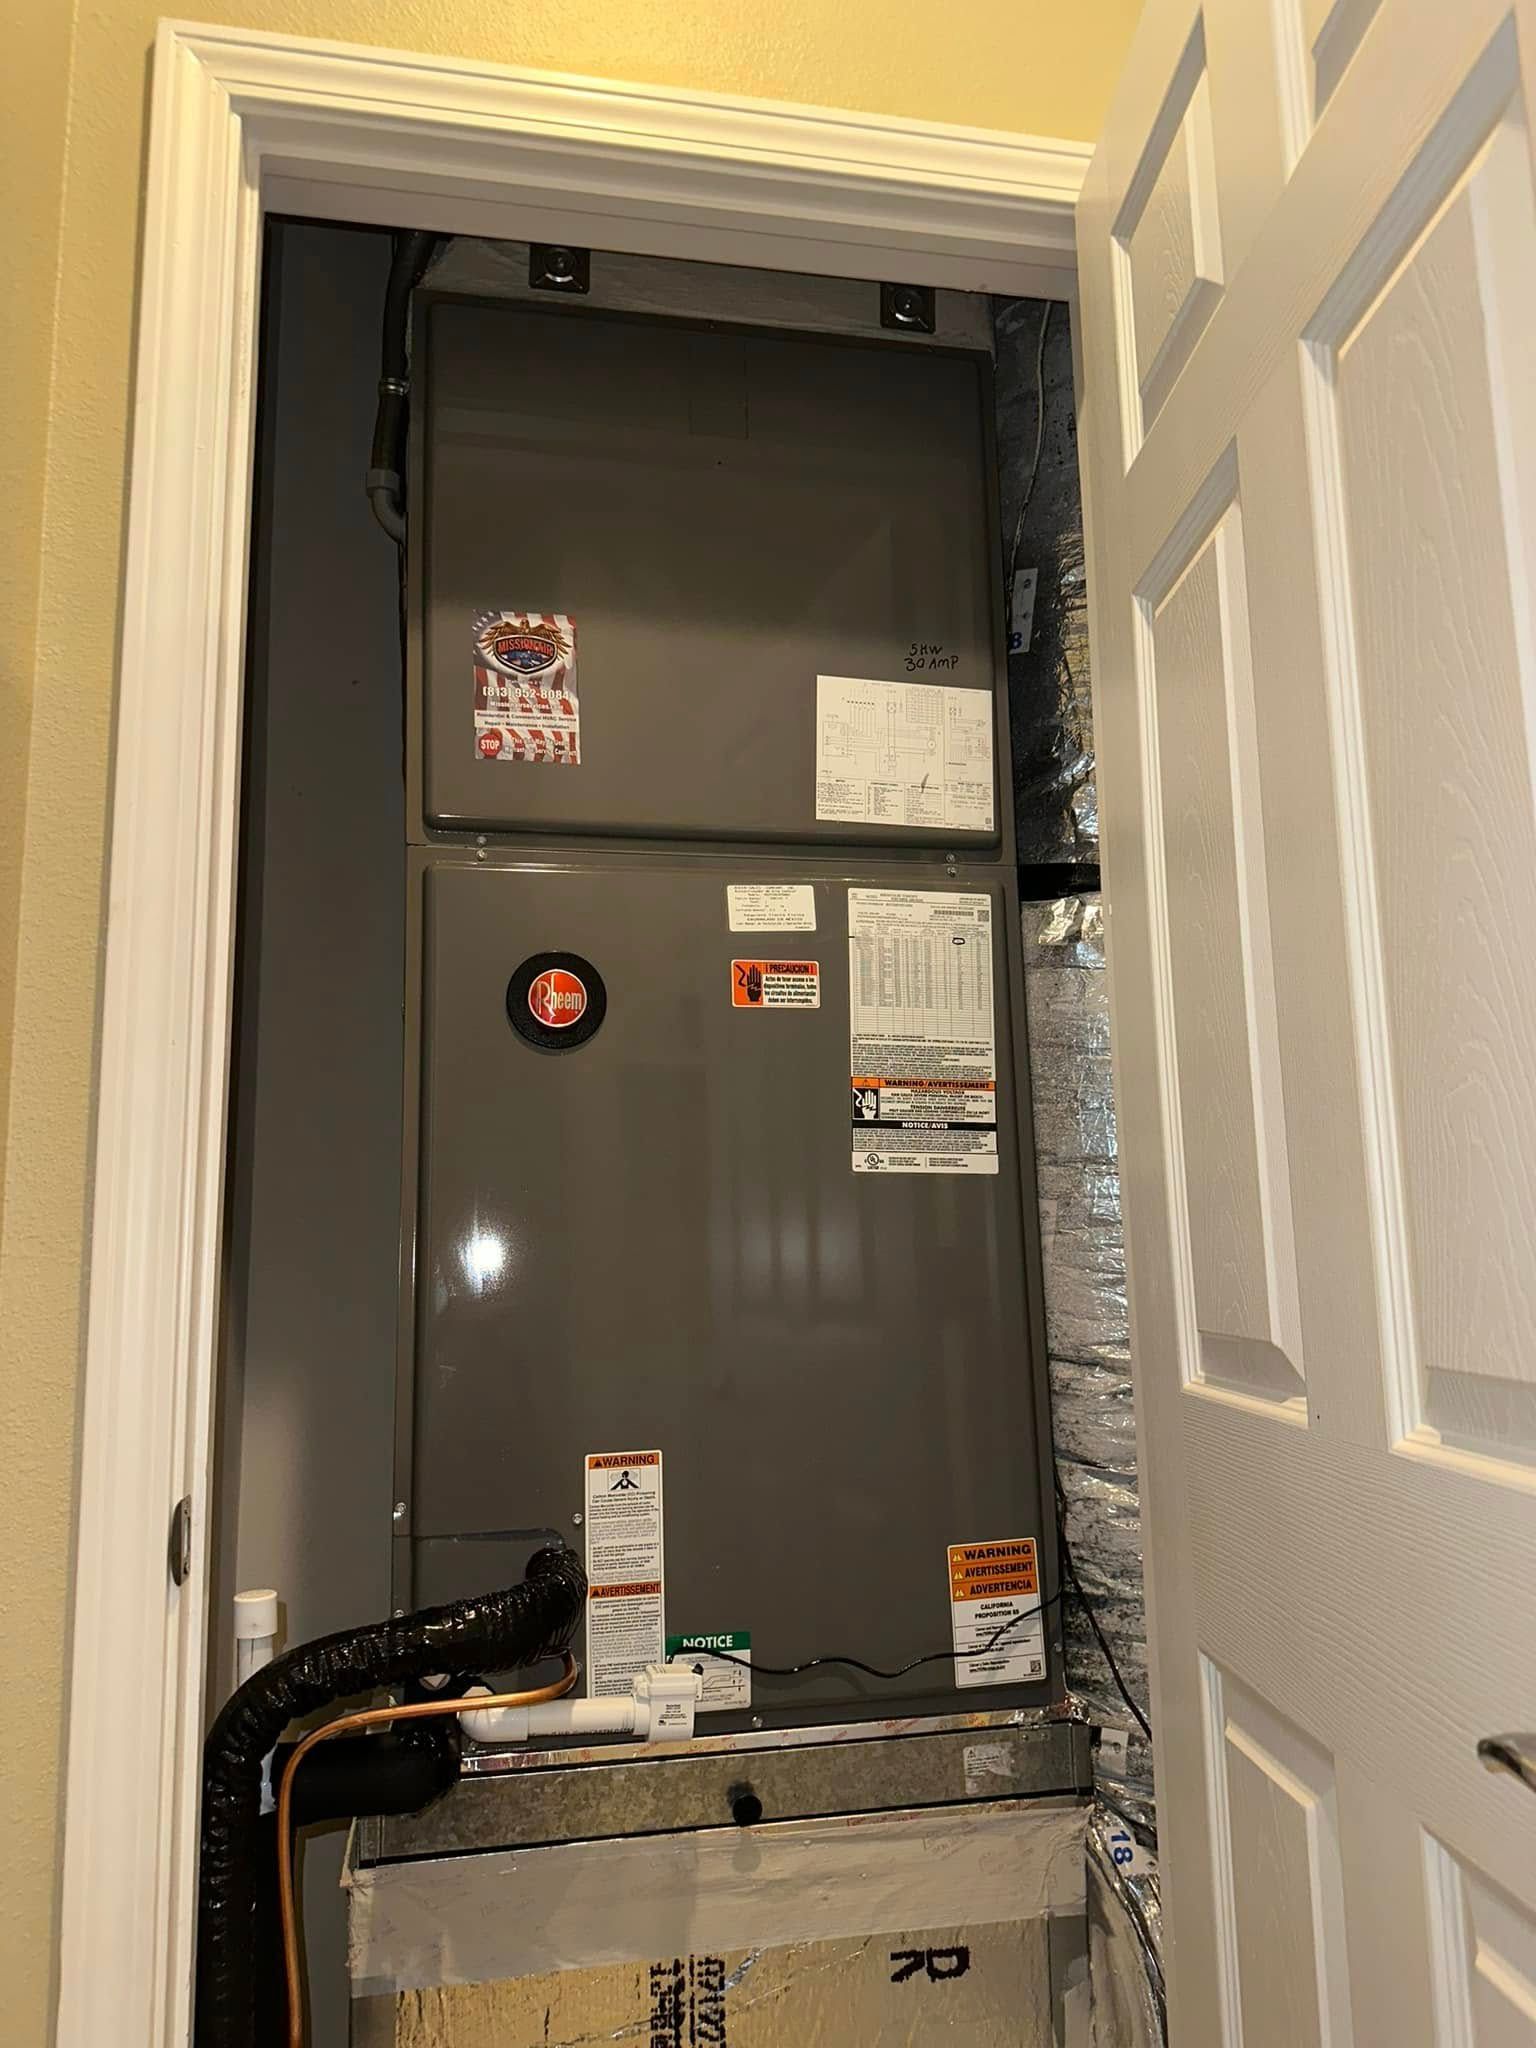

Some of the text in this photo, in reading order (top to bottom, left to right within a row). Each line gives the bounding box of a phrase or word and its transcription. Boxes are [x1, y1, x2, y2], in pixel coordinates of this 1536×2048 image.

[904, 655, 959, 672] 30 AMP
[515, 688, 569, 700] 952-8084
[480, 739, 500, 750] STOP
[537, 973, 582, 1018] Rheem
[602, 1454, 655, 1466] WARNING
[964, 1544, 1032, 1561] WARNING
[965, 1561, 1033, 1578] AVERTISSEMENT
[600, 1583, 660, 1598] AVERTISSEMENT
[969, 1579, 1033, 1595] ADVERTENCIA
[980, 1601, 1014, 1610] CALIFORNIA
[974, 1610, 1012, 1620] PROPOSITION
[682, 1635, 733, 1649] NOTICE
[1110, 1829, 1135, 1865] 18
